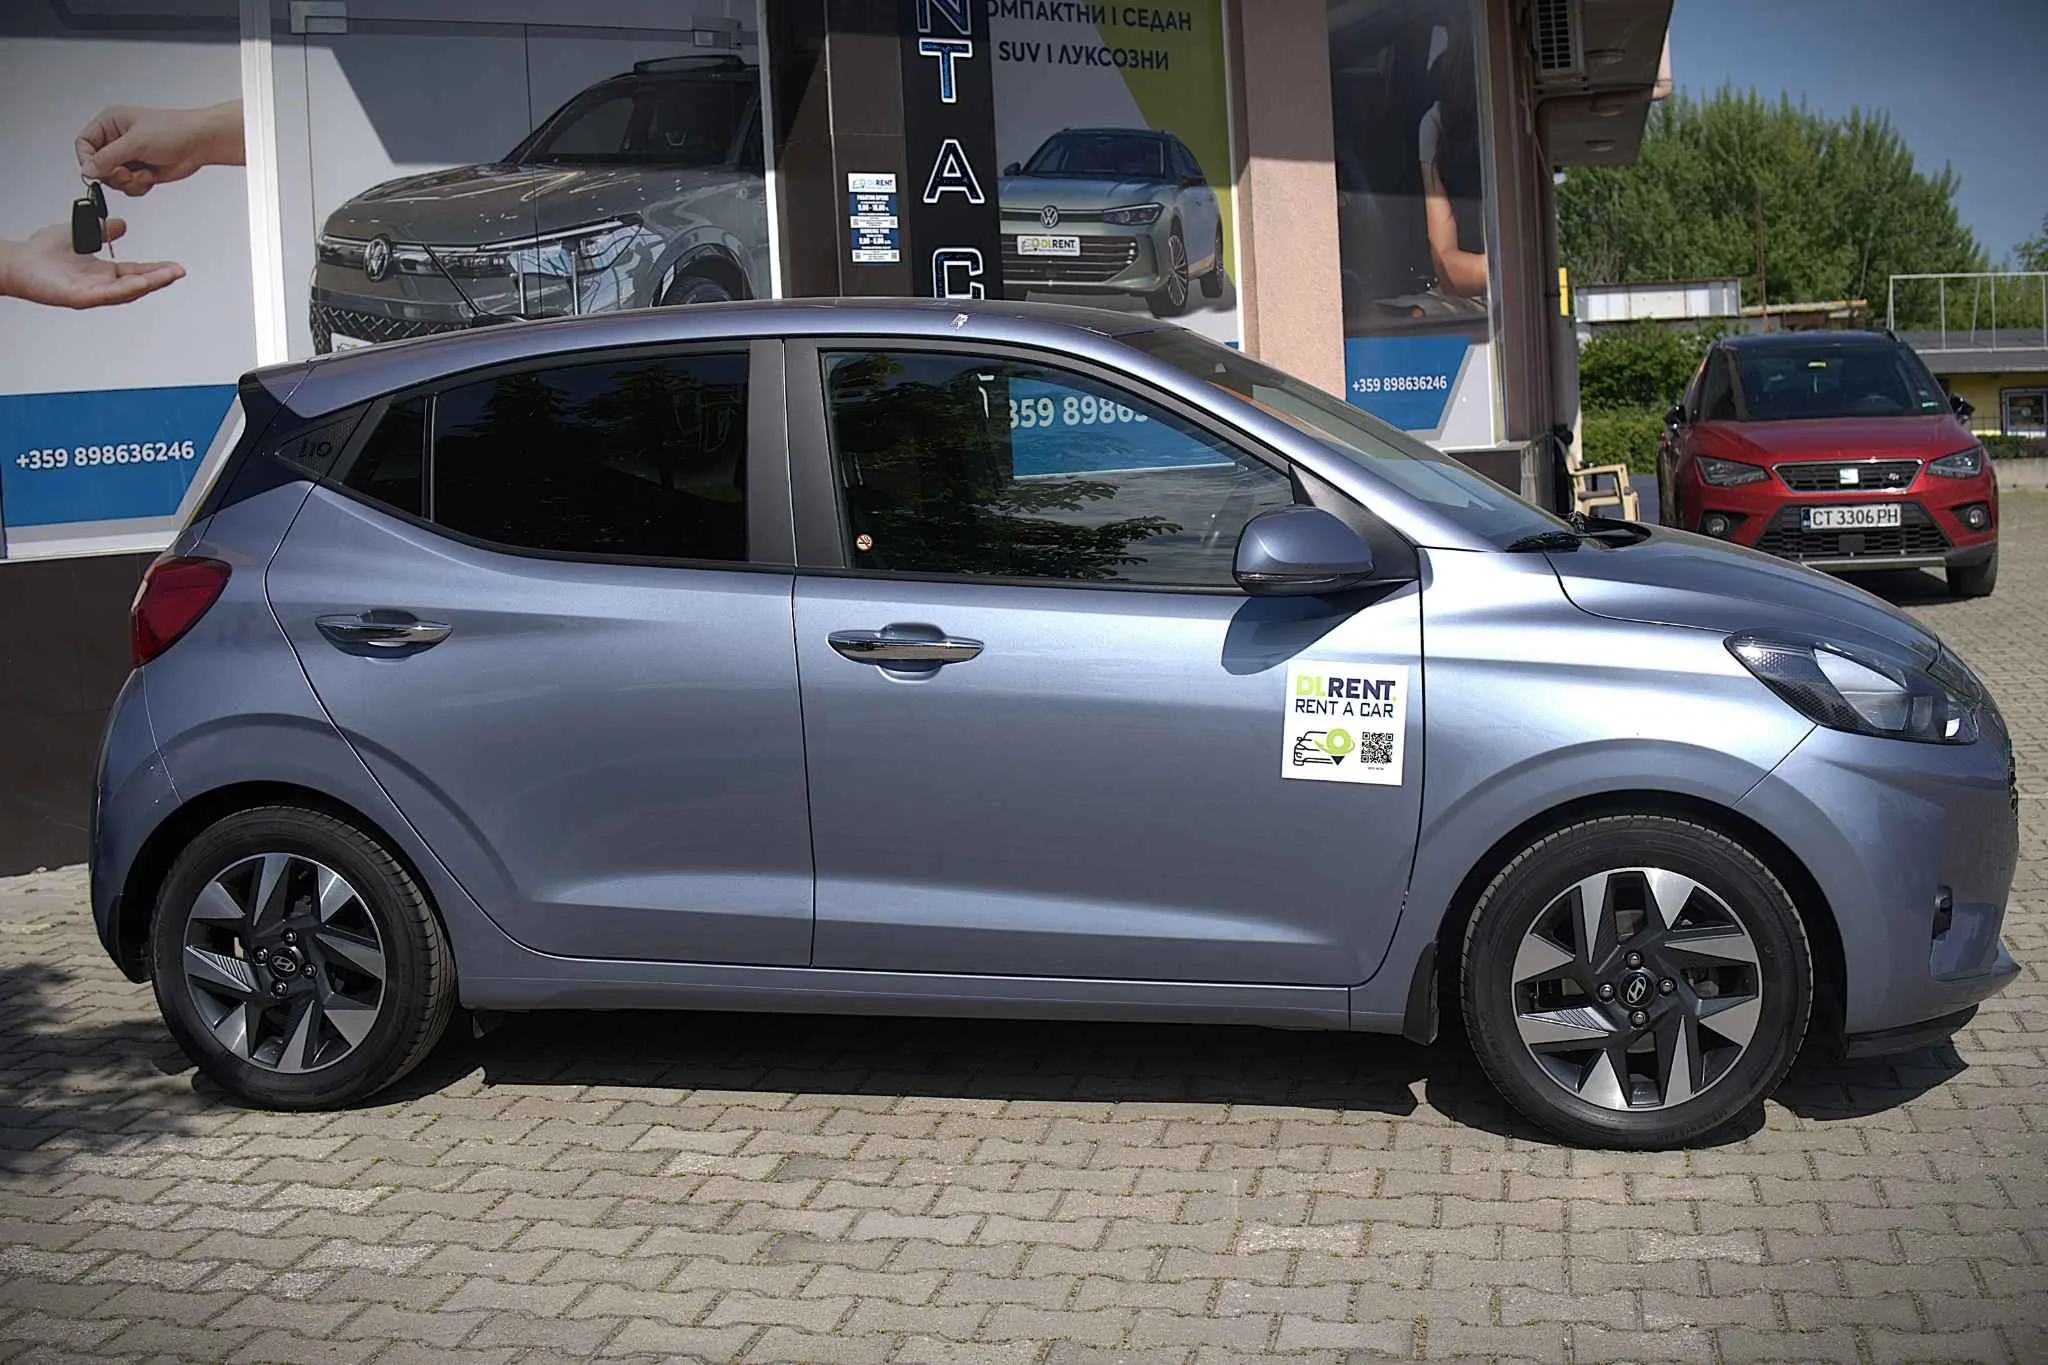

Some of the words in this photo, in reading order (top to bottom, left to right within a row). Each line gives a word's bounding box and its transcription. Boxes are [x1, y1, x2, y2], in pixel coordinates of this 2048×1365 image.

[1122, 8, 1192, 32] СЕДАН
[999, 41, 1040, 63] SUV
[1058, 45, 1169, 71] ЛУКСОЗНИ
[1352, 377, 1381, 392] +359
[1383, 375, 1448, 392] 898636246
[1063, 395, 1149, 426] 8986
[16, 448, 68, 470] +359
[74, 440, 195, 467] 898636246
[1836, 509, 1874, 526] 3306
[1295, 698, 1339, 716] RENT
[1342, 701, 1354, 717] A
[1360, 702, 1394, 719] CAR
